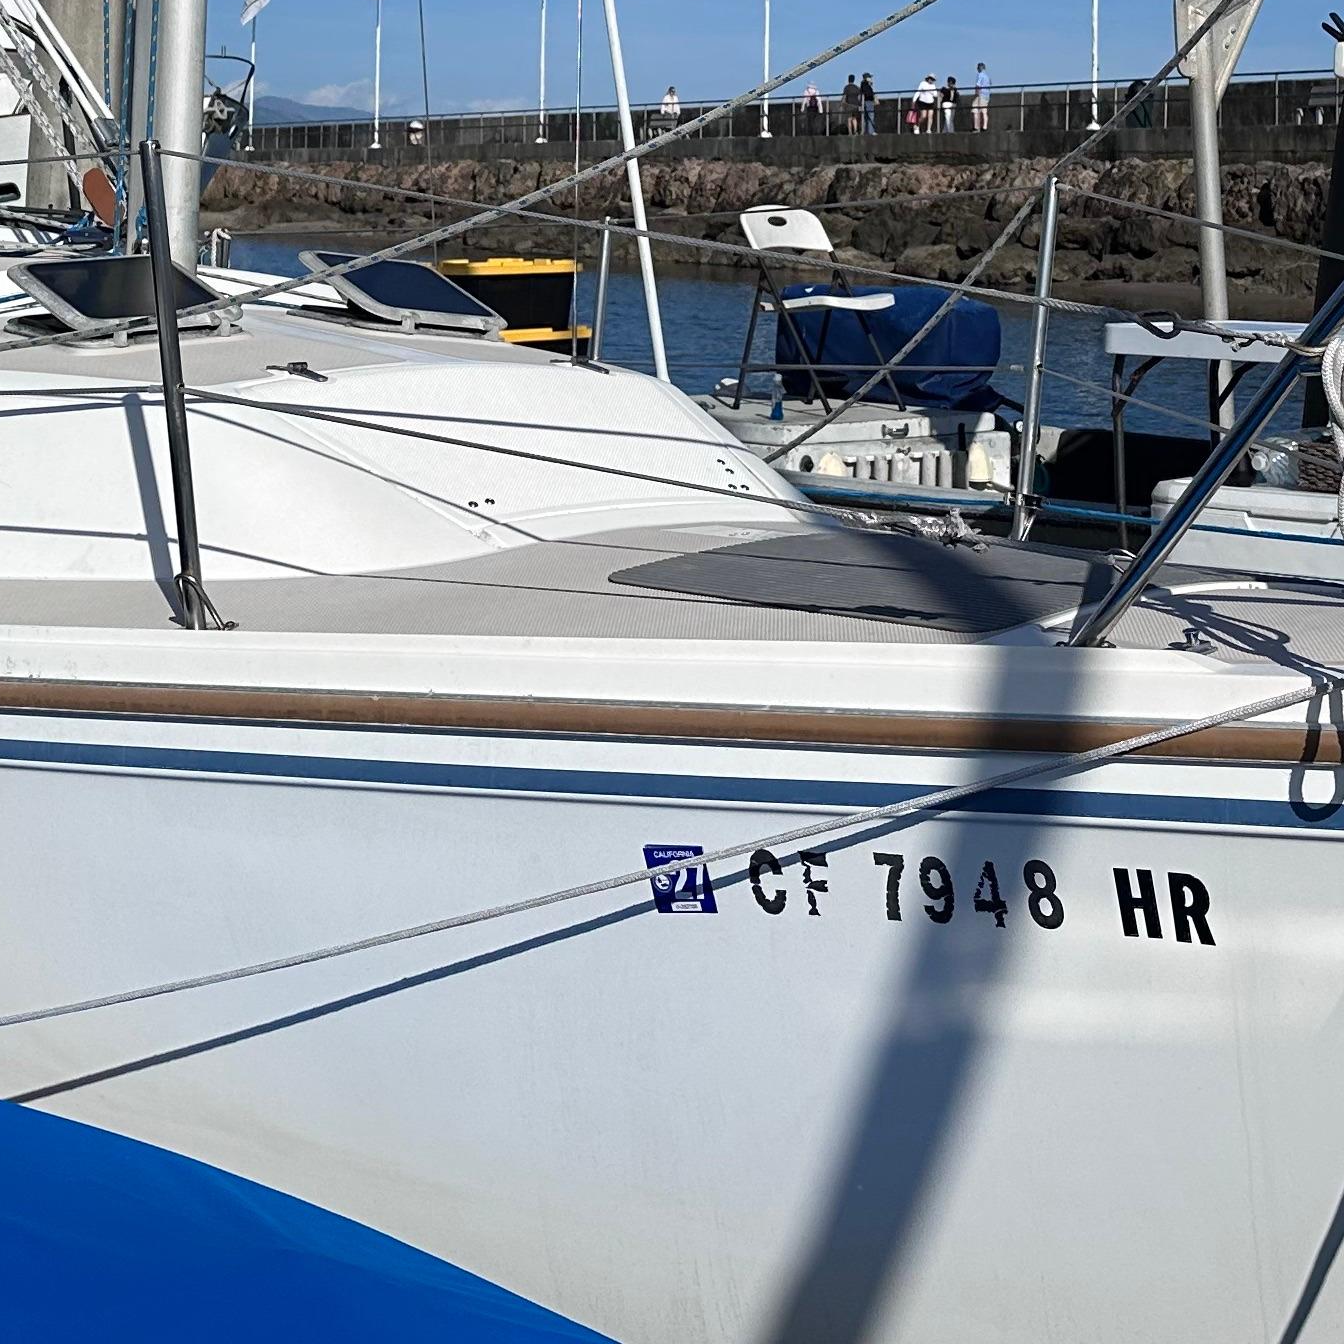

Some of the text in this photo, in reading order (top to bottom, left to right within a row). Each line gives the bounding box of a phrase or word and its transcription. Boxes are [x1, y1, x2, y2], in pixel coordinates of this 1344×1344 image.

[748, 848, 1217, 947] CF 7948 HR
